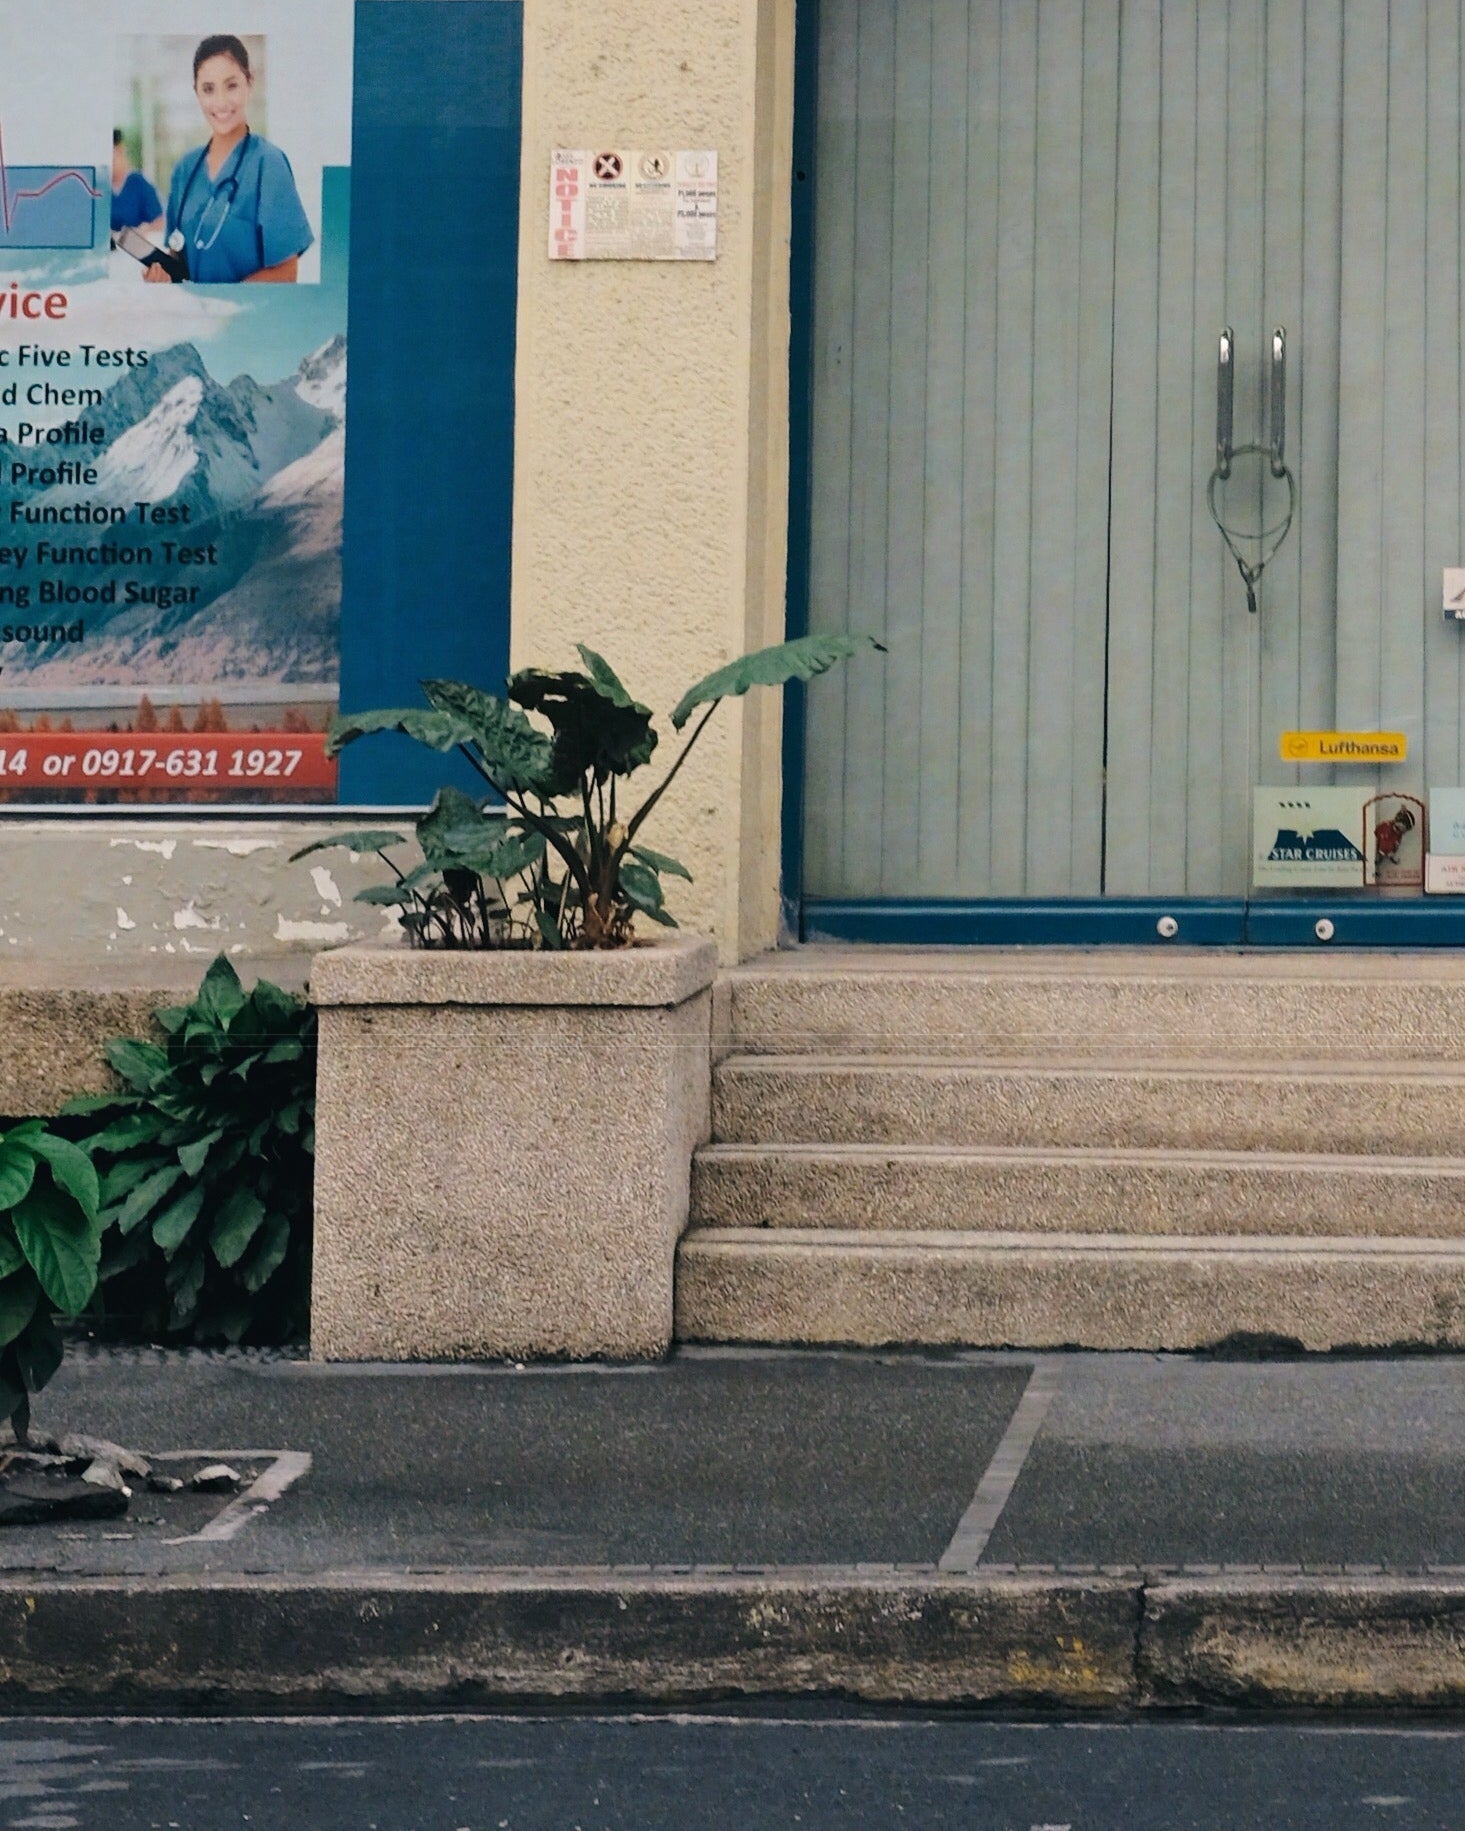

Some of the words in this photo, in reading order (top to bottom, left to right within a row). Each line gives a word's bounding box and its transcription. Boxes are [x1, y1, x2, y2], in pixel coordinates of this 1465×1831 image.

[555, 168, 579, 257] NOTICE
[19, 344, 71, 367] Five
[80, 344, 149, 367] Tests
[2, 382, 17, 406] d
[27, 382, 103, 406] Chem
[19, 420, 105, 445] Profile
[11, 461, 98, 485] Profile
[11, 501, 126, 524] Function
[134, 502, 191, 524] Test
[0, 548, 28, 569] ey
[37, 541, 152, 566] Function
[161, 541, 218, 566] Test
[0, 585, 30, 609] ng
[39, 579, 116, 604] Blood
[124, 580, 201, 610] Sugar
[2, 619, 85, 643] sound
[1320, 739, 1400, 755] Lufthansa
[43, 754, 77, 776] or
[82, 748, 219, 777] 0917-631
[228, 748, 303, 777] 1927
[1272, 848, 1303, 860] STAR
[1305, 848, 1359, 861] CRUISES
